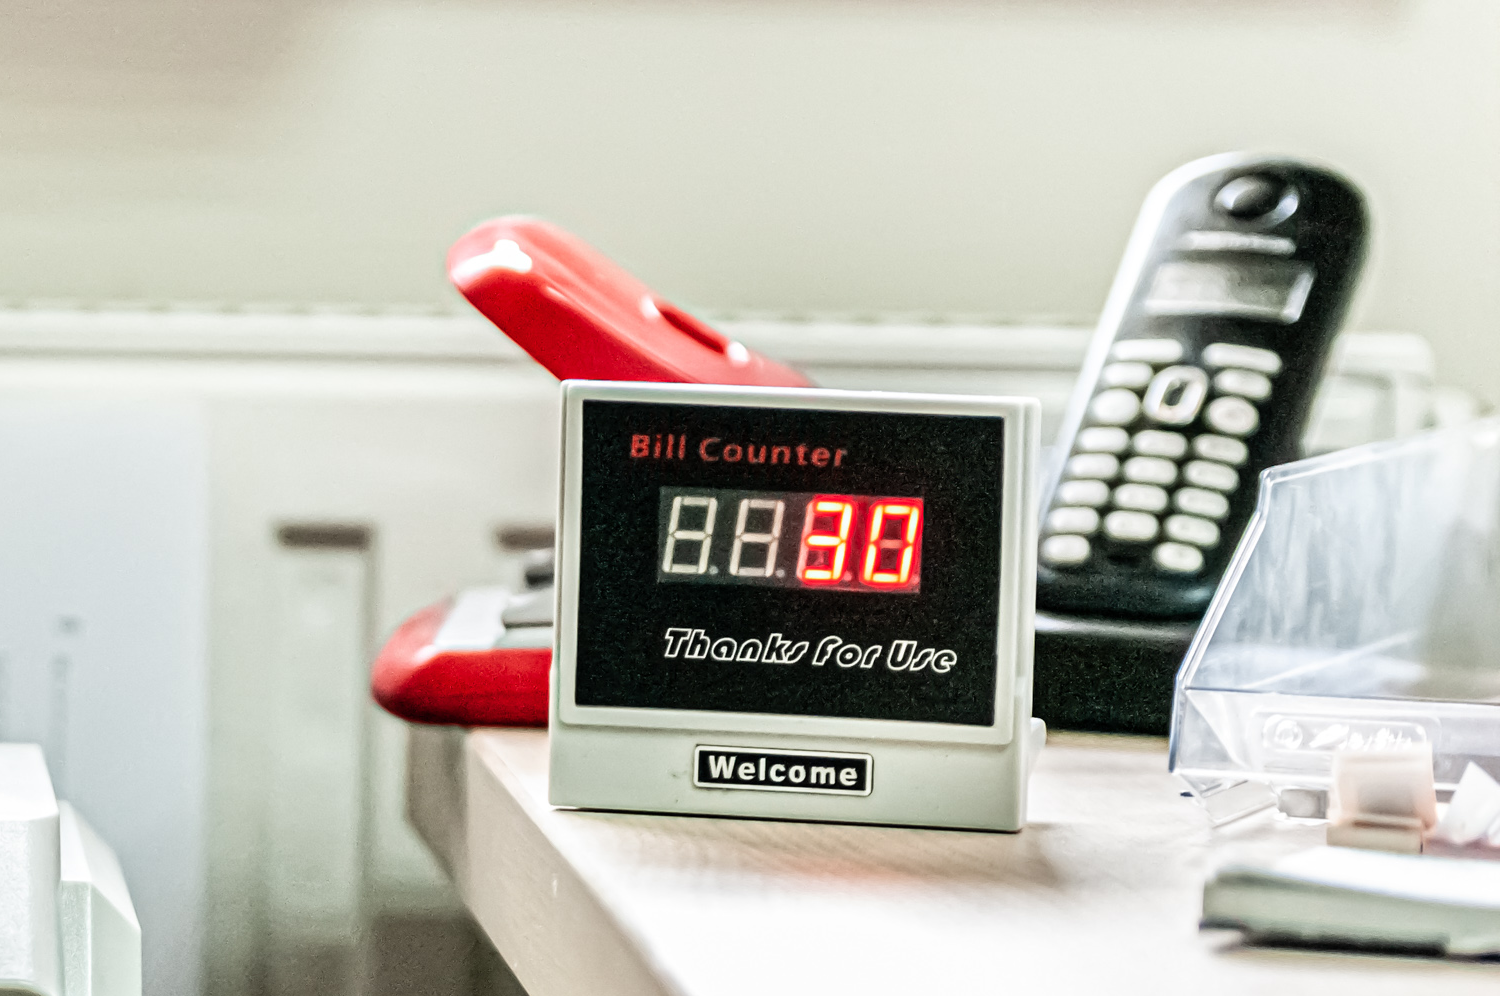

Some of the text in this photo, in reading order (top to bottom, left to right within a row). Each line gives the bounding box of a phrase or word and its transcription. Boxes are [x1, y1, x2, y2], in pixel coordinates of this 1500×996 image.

[630, 434, 849, 468] Bill Counter
[664, 627, 809, 665] Thanks
[887, 639, 958, 674] Use
[708, 755, 858, 787] Welcome
